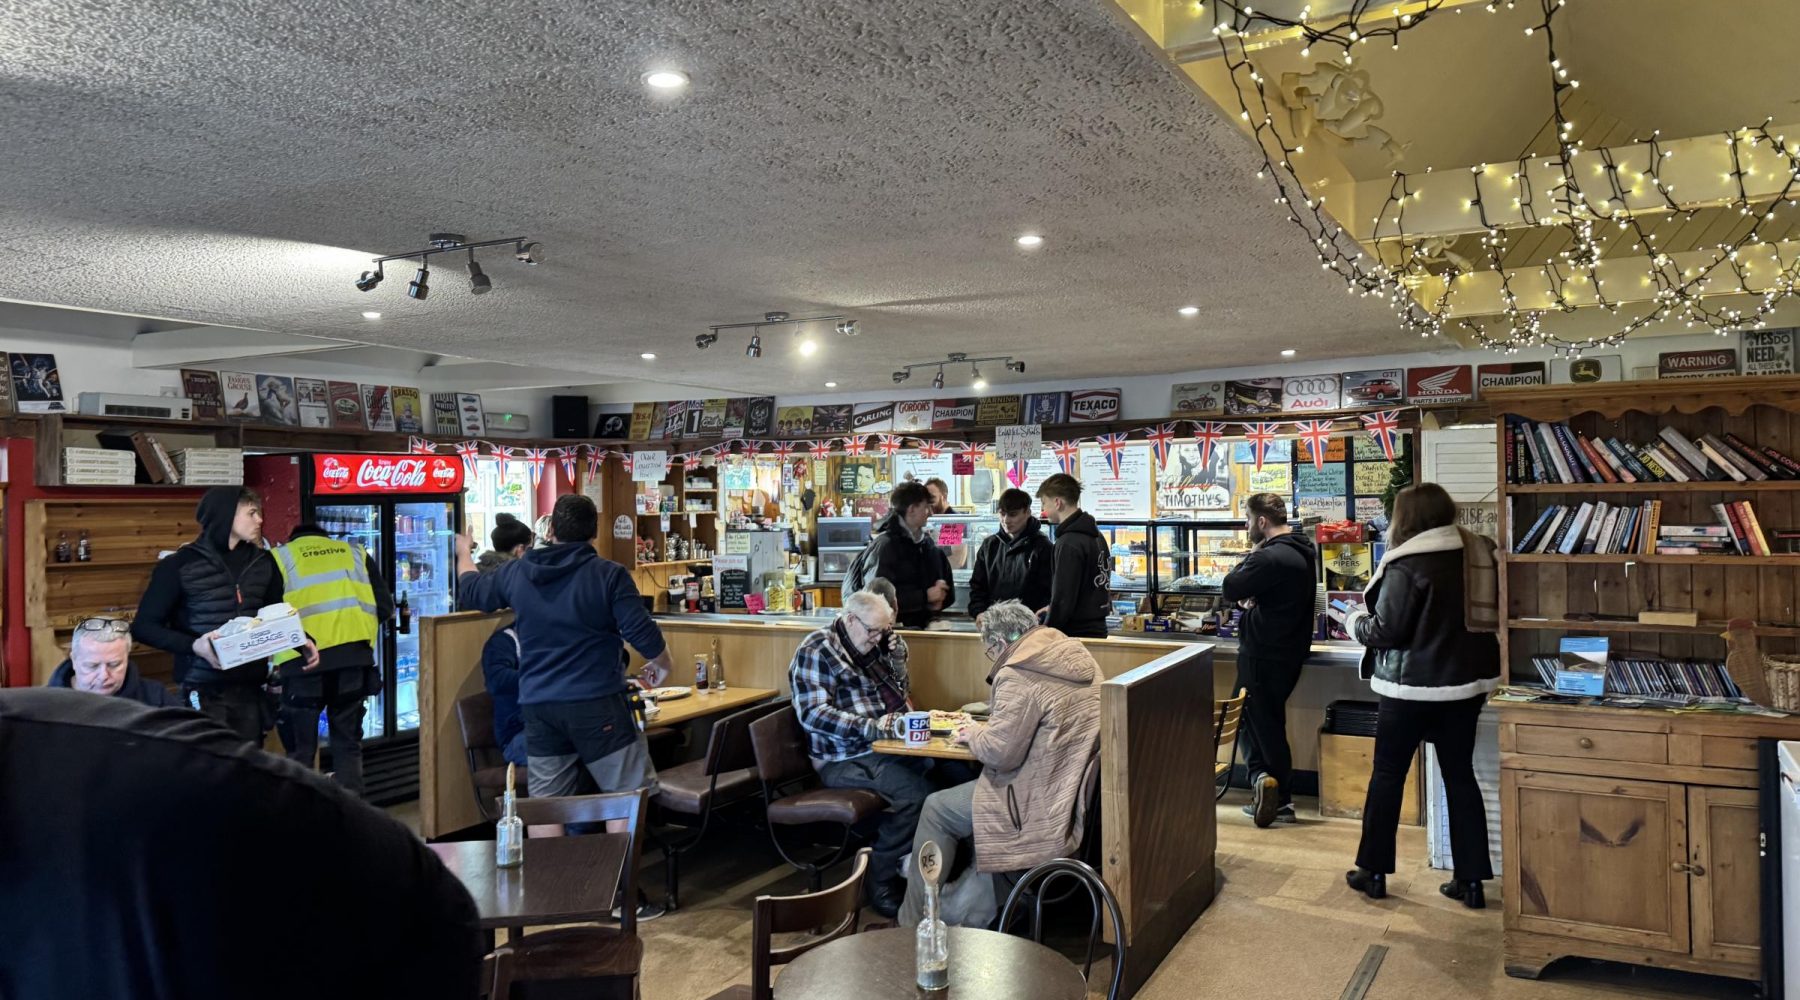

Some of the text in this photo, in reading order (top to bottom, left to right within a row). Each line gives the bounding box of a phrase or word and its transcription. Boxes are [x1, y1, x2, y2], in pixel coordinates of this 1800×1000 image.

[1754, 331, 1790, 346] YES DO
[1747, 346, 1774, 362] NEED
[1667, 355, 1727, 368] WARNING
[1747, 361, 1774, 370] ALL THESE
[1481, 375, 1542, 387] CHAMPION
[393, 387, 418, 399] BRASSO
[899, 400, 930, 413] GORDON'S
[1073, 399, 1117, 411] TEXACO
[1290, 399, 1329, 409] Audi
[854, 408, 892, 425] CARLING
[935, 408, 974, 418] CHAMPION
[356, 458, 427, 487] Coca-Cola
[1164, 493, 1221, 507] TIMOTHY'S
[302, 547, 346, 558] creative
